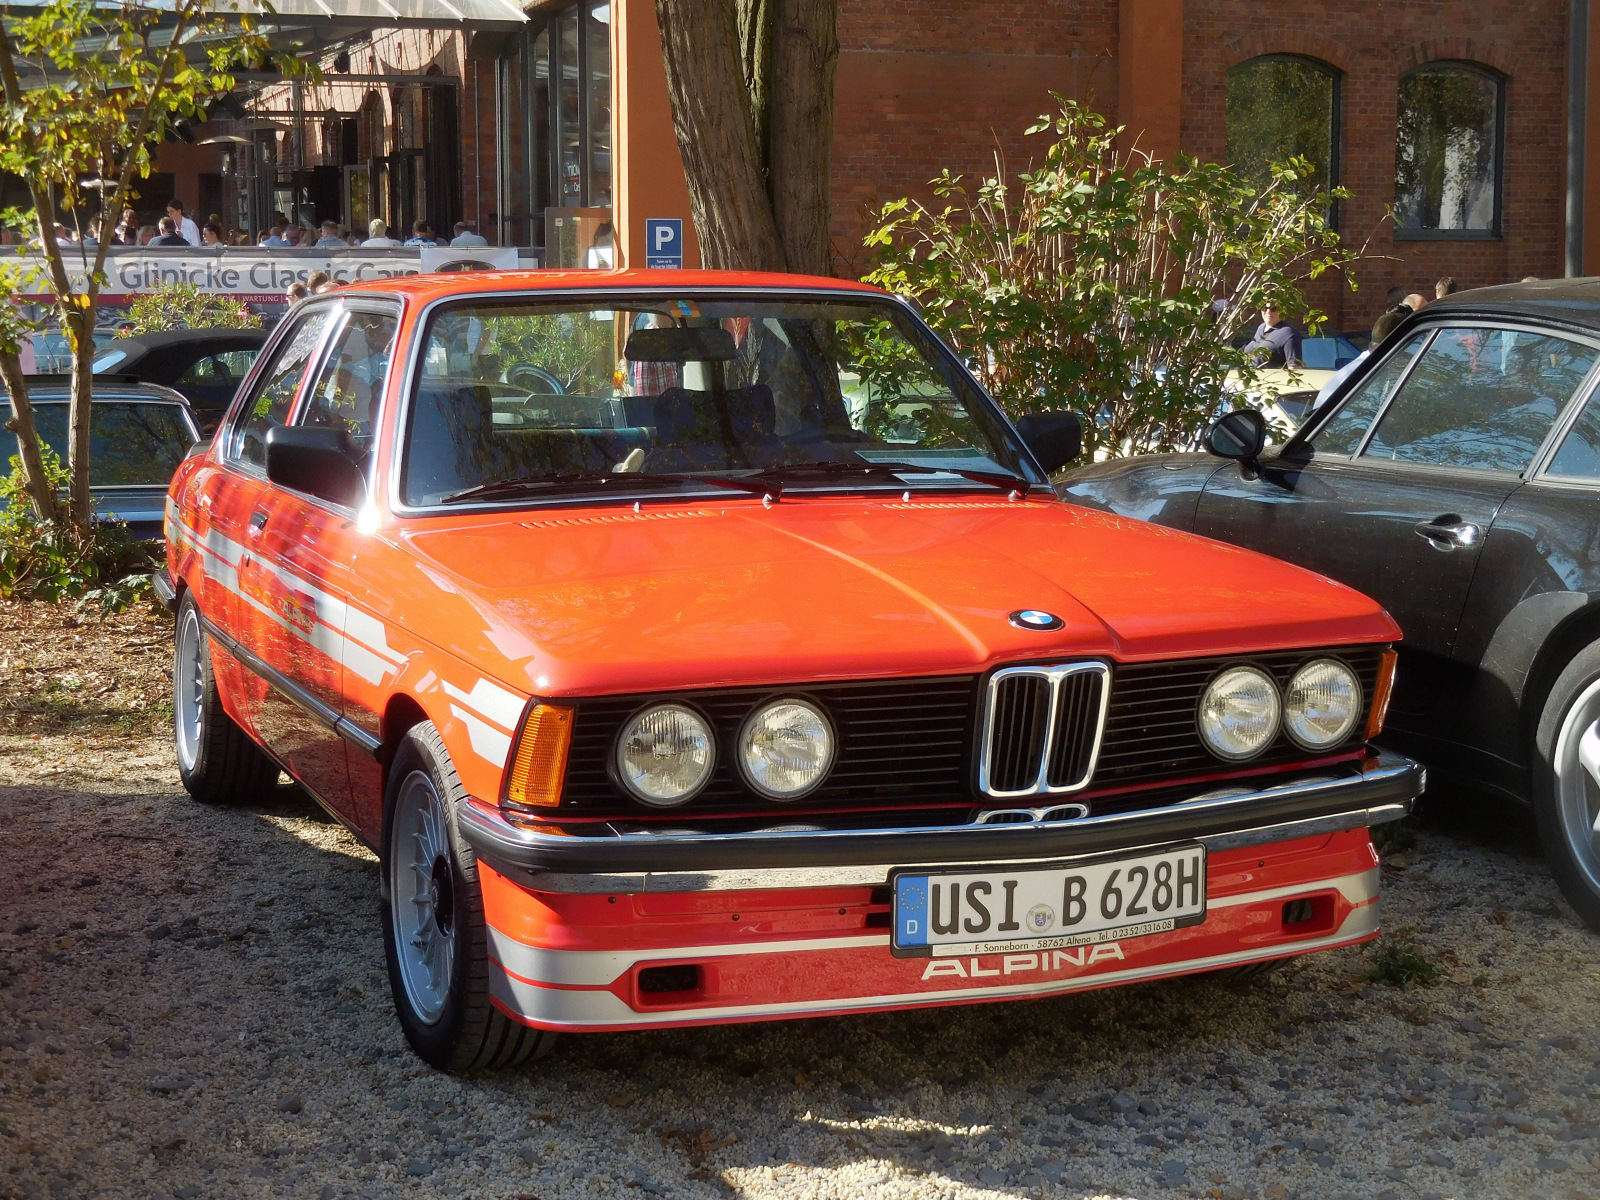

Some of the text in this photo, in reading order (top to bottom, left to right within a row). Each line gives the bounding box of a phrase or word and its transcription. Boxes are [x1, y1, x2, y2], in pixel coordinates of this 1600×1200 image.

[656, 226, 674, 250] P
[119, 262, 240, 289] Glinicke
[906, 856, 1199, 935] D USI B 628H
[984, 942, 1029, 952] Sonneborn
[1037, 938, 1064, 949] 58762
[1066, 936, 1091, 945] Altena
[1098, 932, 1110, 941] Tel.
[921, 942, 1125, 980] ALPINA
